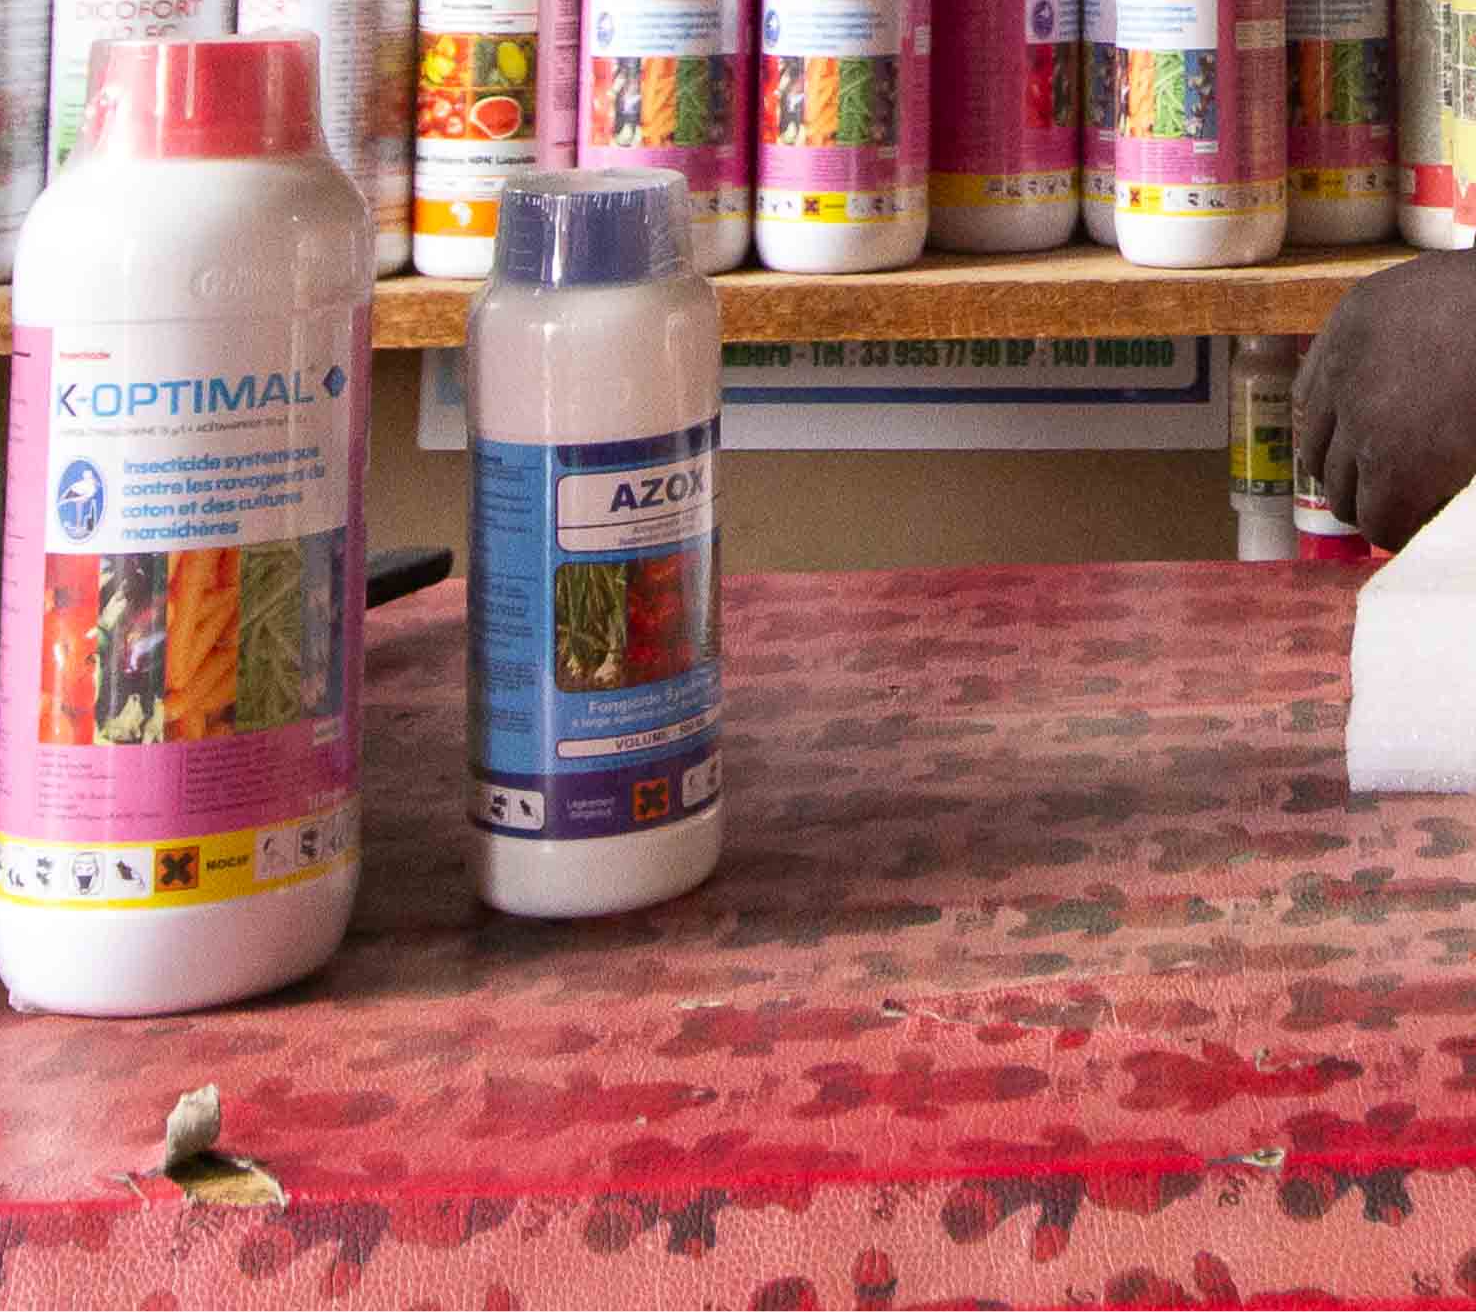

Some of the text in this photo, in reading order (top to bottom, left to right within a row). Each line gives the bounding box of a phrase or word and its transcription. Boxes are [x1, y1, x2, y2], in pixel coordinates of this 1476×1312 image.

[56, 370, 316, 418] K-OPTIMAL
[123, 451, 222, 475] Insecticide
[122, 480, 182, 497] contre
[185, 478, 214, 495] les
[610, 467, 705, 513] AZOX
[121, 501, 175, 520] coton
[177, 498, 200, 516] et
[201, 494, 237, 515] des
